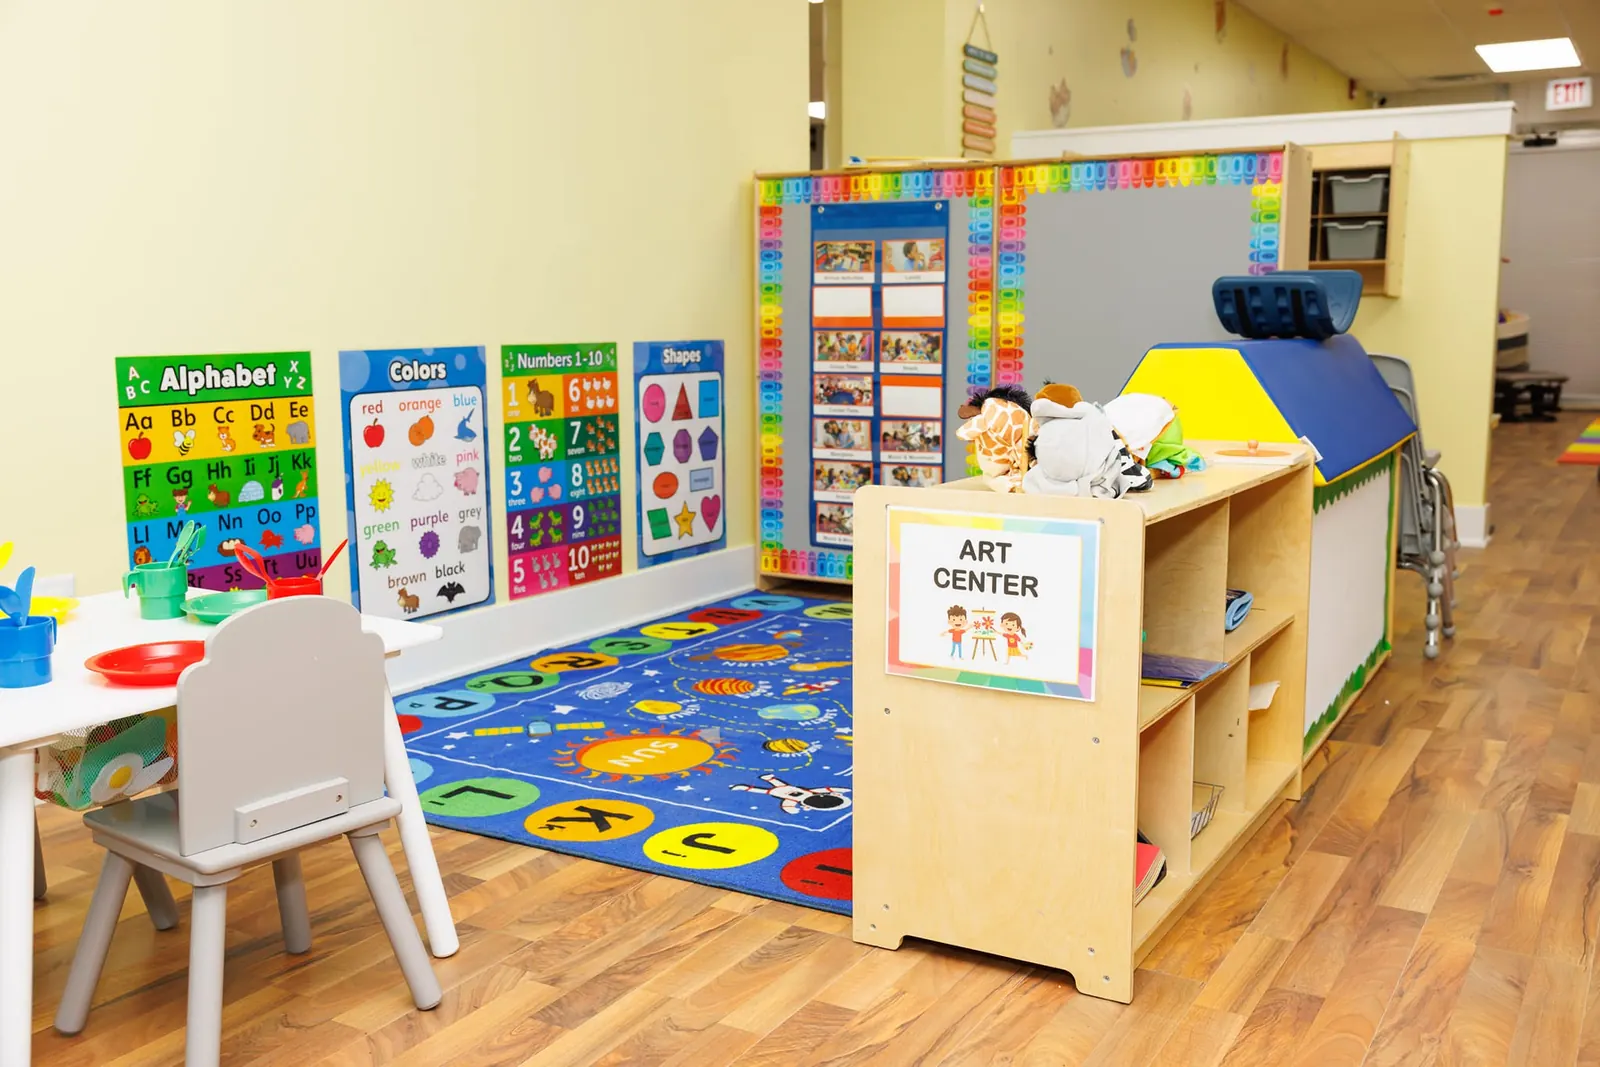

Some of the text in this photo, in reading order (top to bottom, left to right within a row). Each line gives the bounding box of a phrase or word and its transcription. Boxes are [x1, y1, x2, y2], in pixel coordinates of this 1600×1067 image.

[289, 360, 299, 373] X
[517, 352, 572, 369] Numbers
[663, 348, 701, 367] Shapes
[128, 366, 140, 380] A
[160, 363, 276, 395] Alphabet
[389, 360, 447, 382] Colors
[508, 382, 519, 407] 1
[569, 378, 581, 402] 6
[125, 402, 309, 431] Aa Bb Cc Dd Ee
[362, 394, 477, 414] red orange blue
[509, 427, 521, 452] 2
[570, 421, 581, 445] 7
[133, 453, 312, 489] Ff Gg Hh Ii Jj Kk
[360, 450, 479, 477] yellow white pink
[571, 463, 583, 486] 8
[510, 471, 523, 496] 3
[218, 513, 243, 531] Nn
[257, 508, 281, 525] Oo
[295, 503, 316, 522] Pp
[363, 507, 482, 539] green purple grey
[511, 515, 524, 539] 4
[572, 505, 584, 529] 9
[568, 545, 589, 571] 10
[959, 539, 1012, 564] ART
[224, 566, 242, 584] Ss
[295, 553, 318, 570] Uu
[388, 561, 466, 588] brown black
[513, 559, 525, 584] 5
[933, 567, 1039, 598] CENTER
[434, 696, 479, 710] P
[607, 740, 679, 767] SUN
[439, 785, 516, 800] L
[546, 805, 634, 833] K
[681, 832, 736, 854] J
